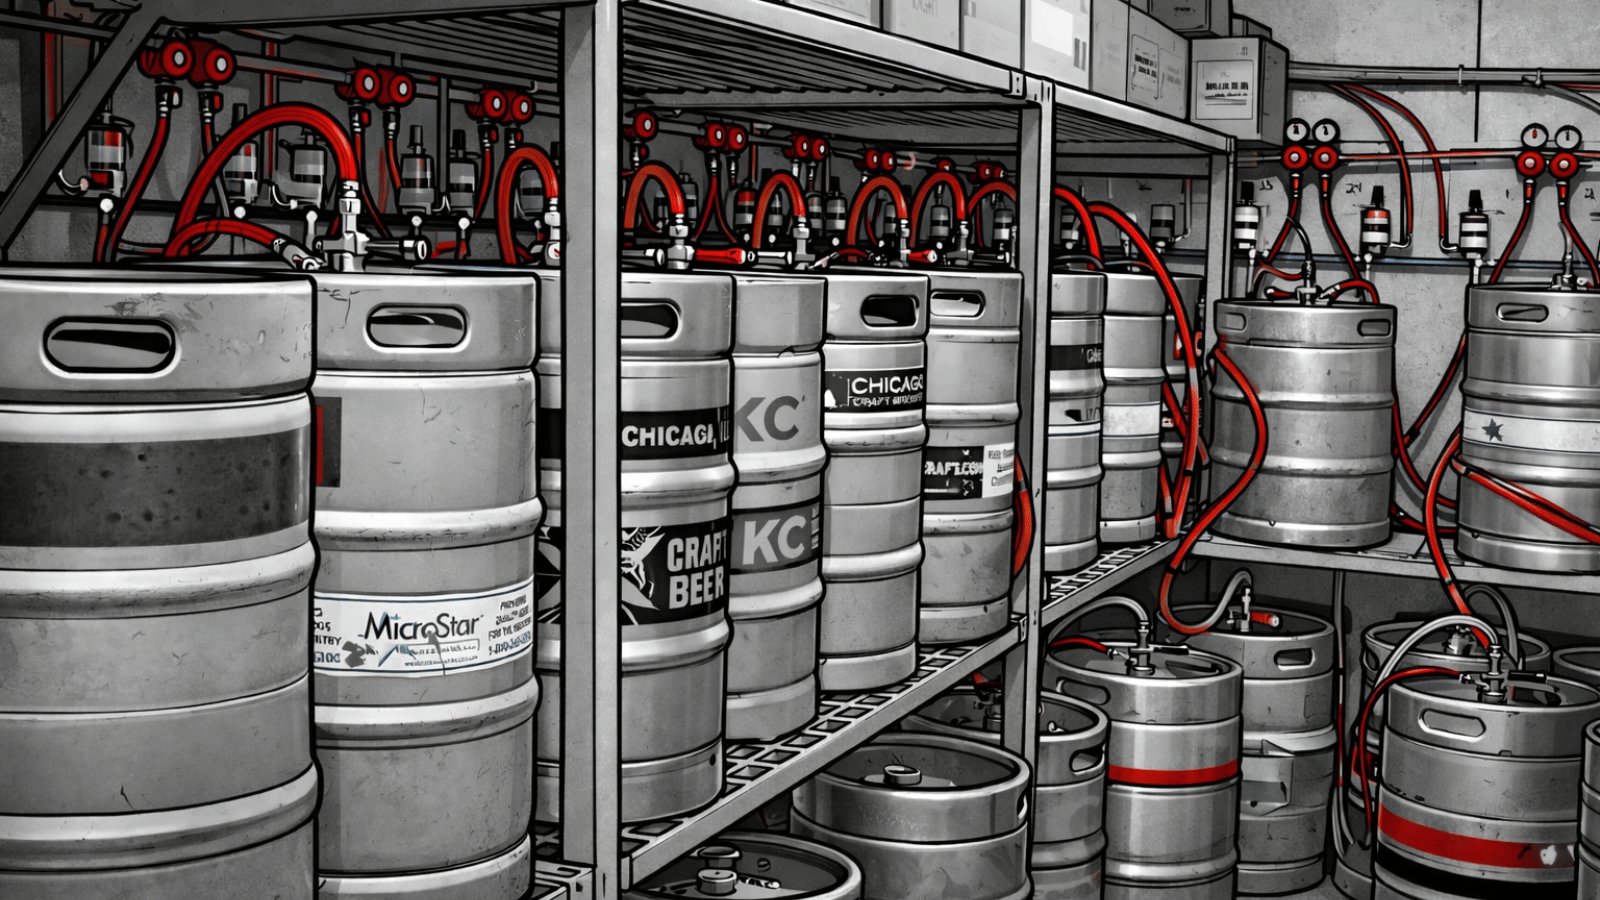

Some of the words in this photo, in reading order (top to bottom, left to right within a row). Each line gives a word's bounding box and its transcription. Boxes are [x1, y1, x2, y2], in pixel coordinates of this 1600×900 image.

[667, 529, 728, 572] CRAFT
[742, 514, 807, 566] KC
[668, 565, 725, 610] BEER
[364, 612, 477, 640] MicroStar
